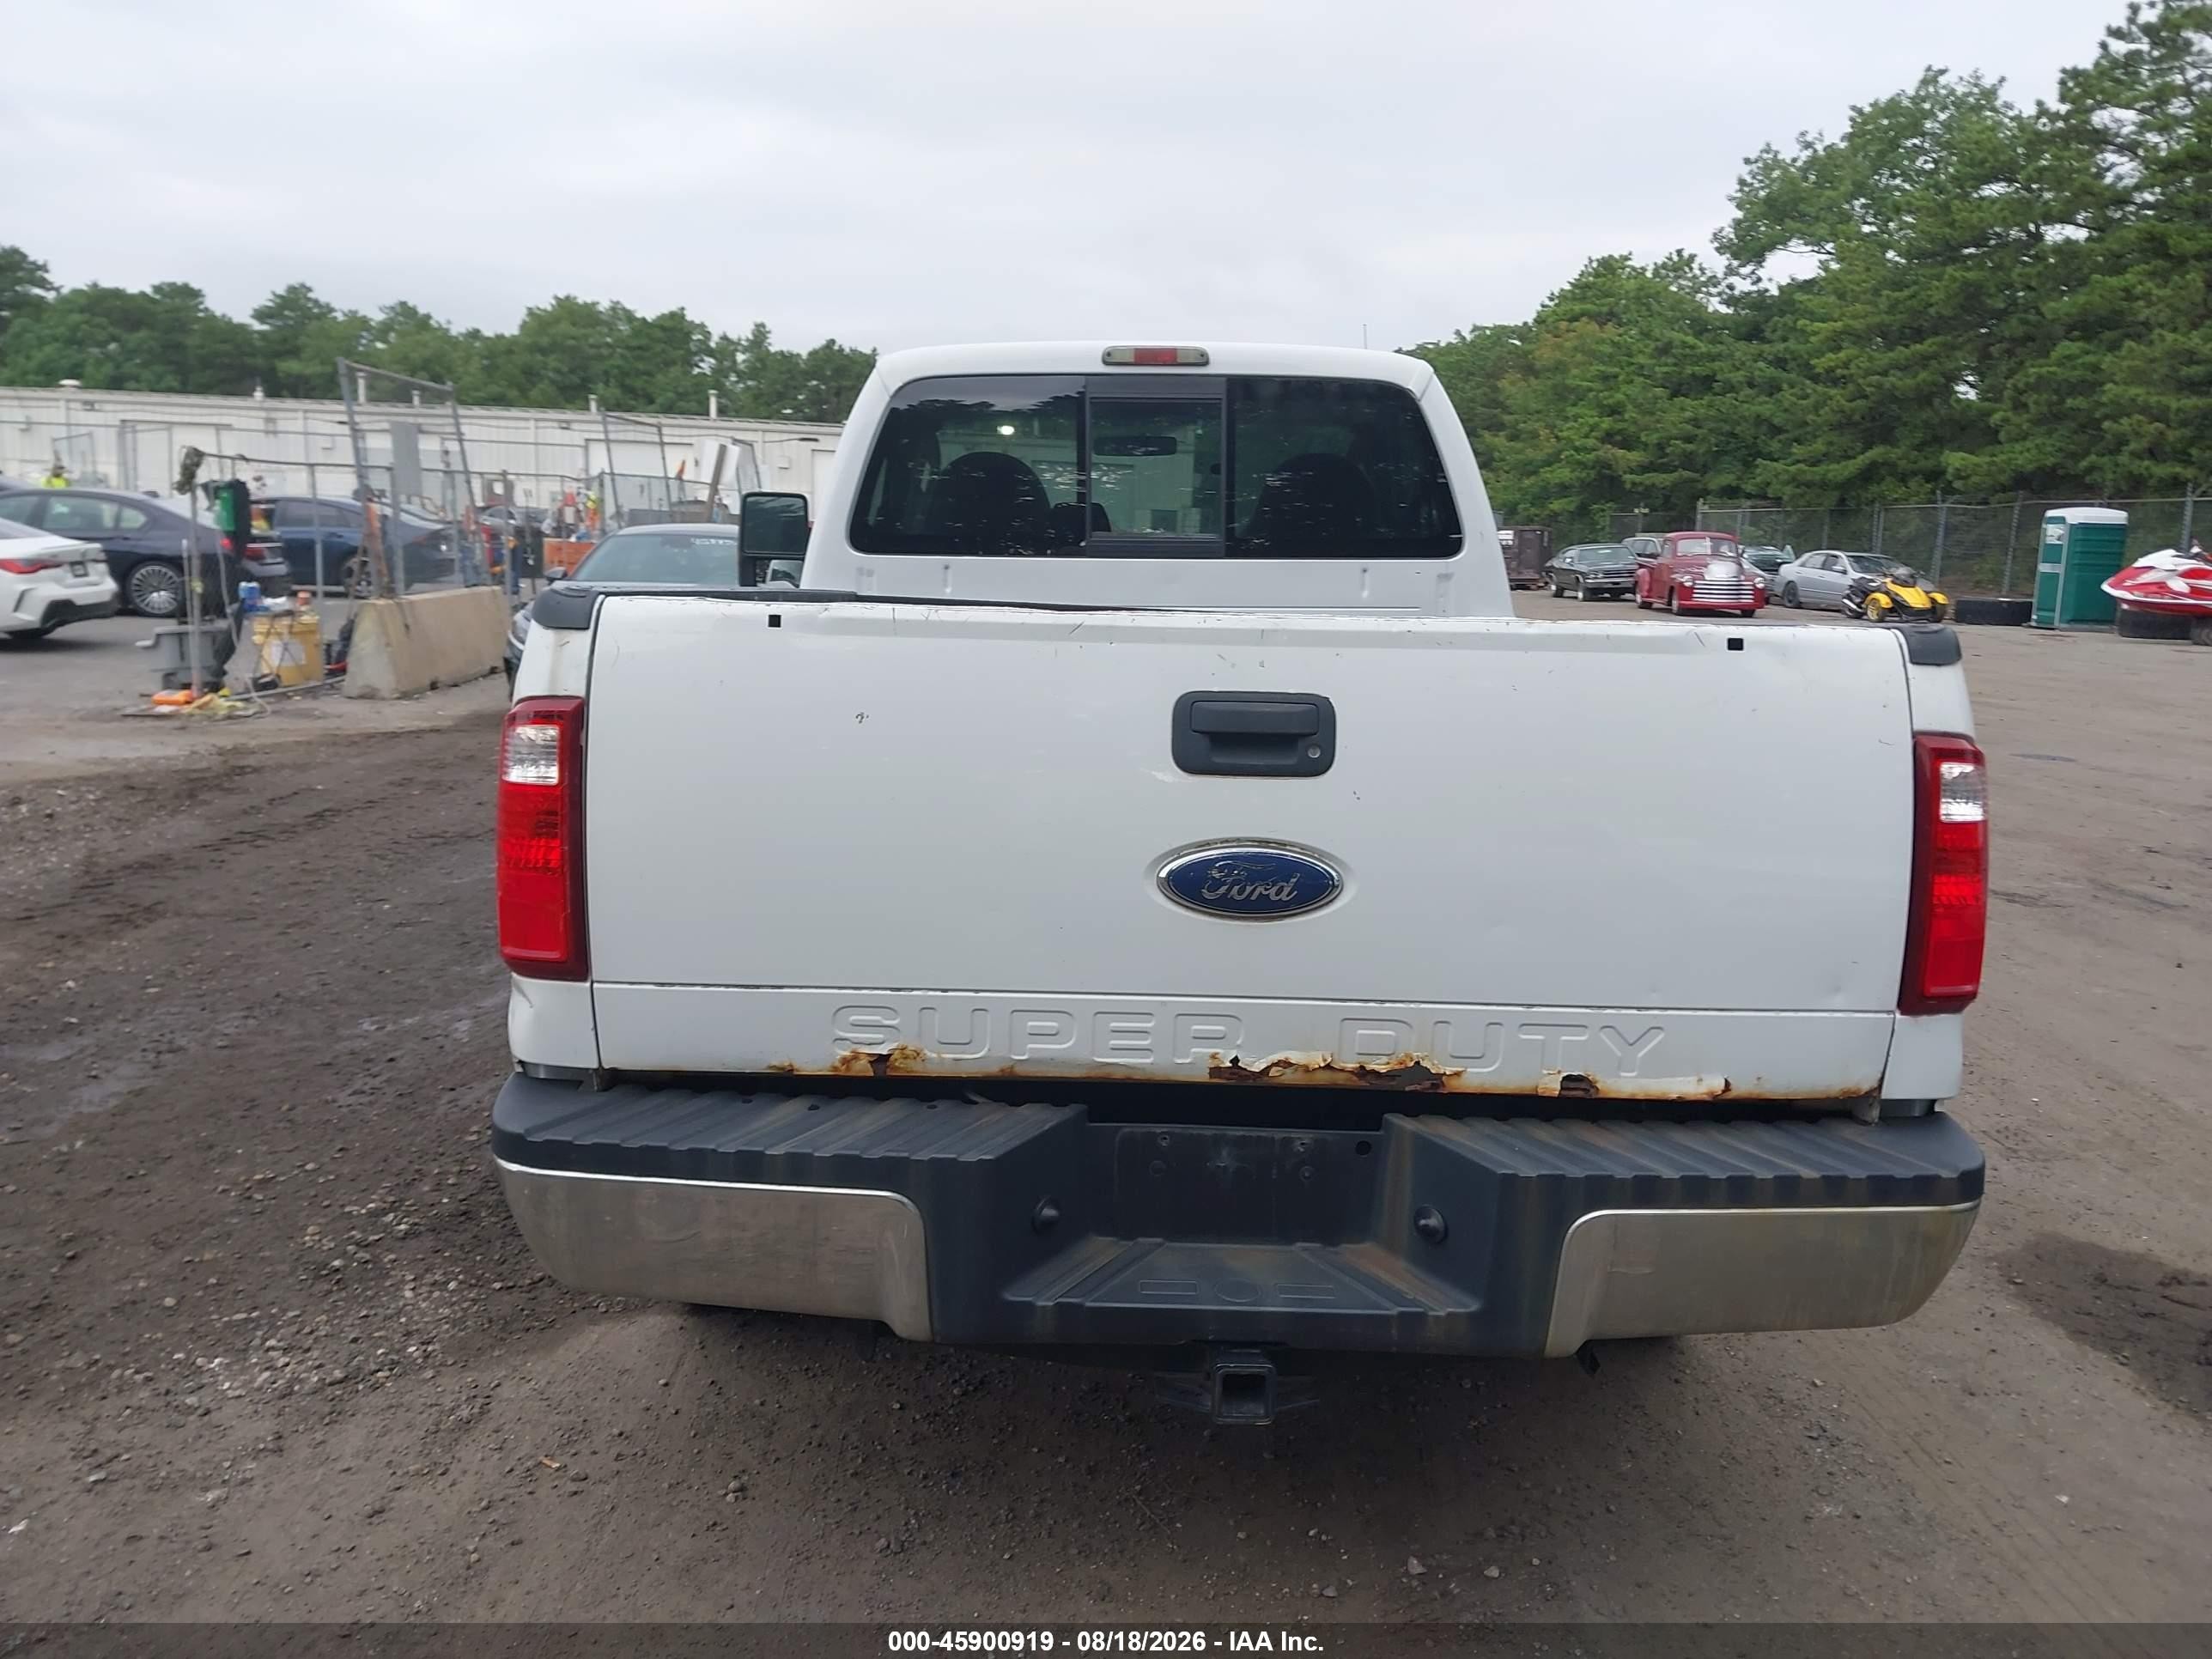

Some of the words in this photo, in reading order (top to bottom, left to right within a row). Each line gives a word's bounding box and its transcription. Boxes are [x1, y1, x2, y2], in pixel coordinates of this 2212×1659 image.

[1201, 860, 1301, 901] Ford
[831, 1005, 1245, 1065] SUPER
[1339, 1018, 1666, 1078] DUTY
